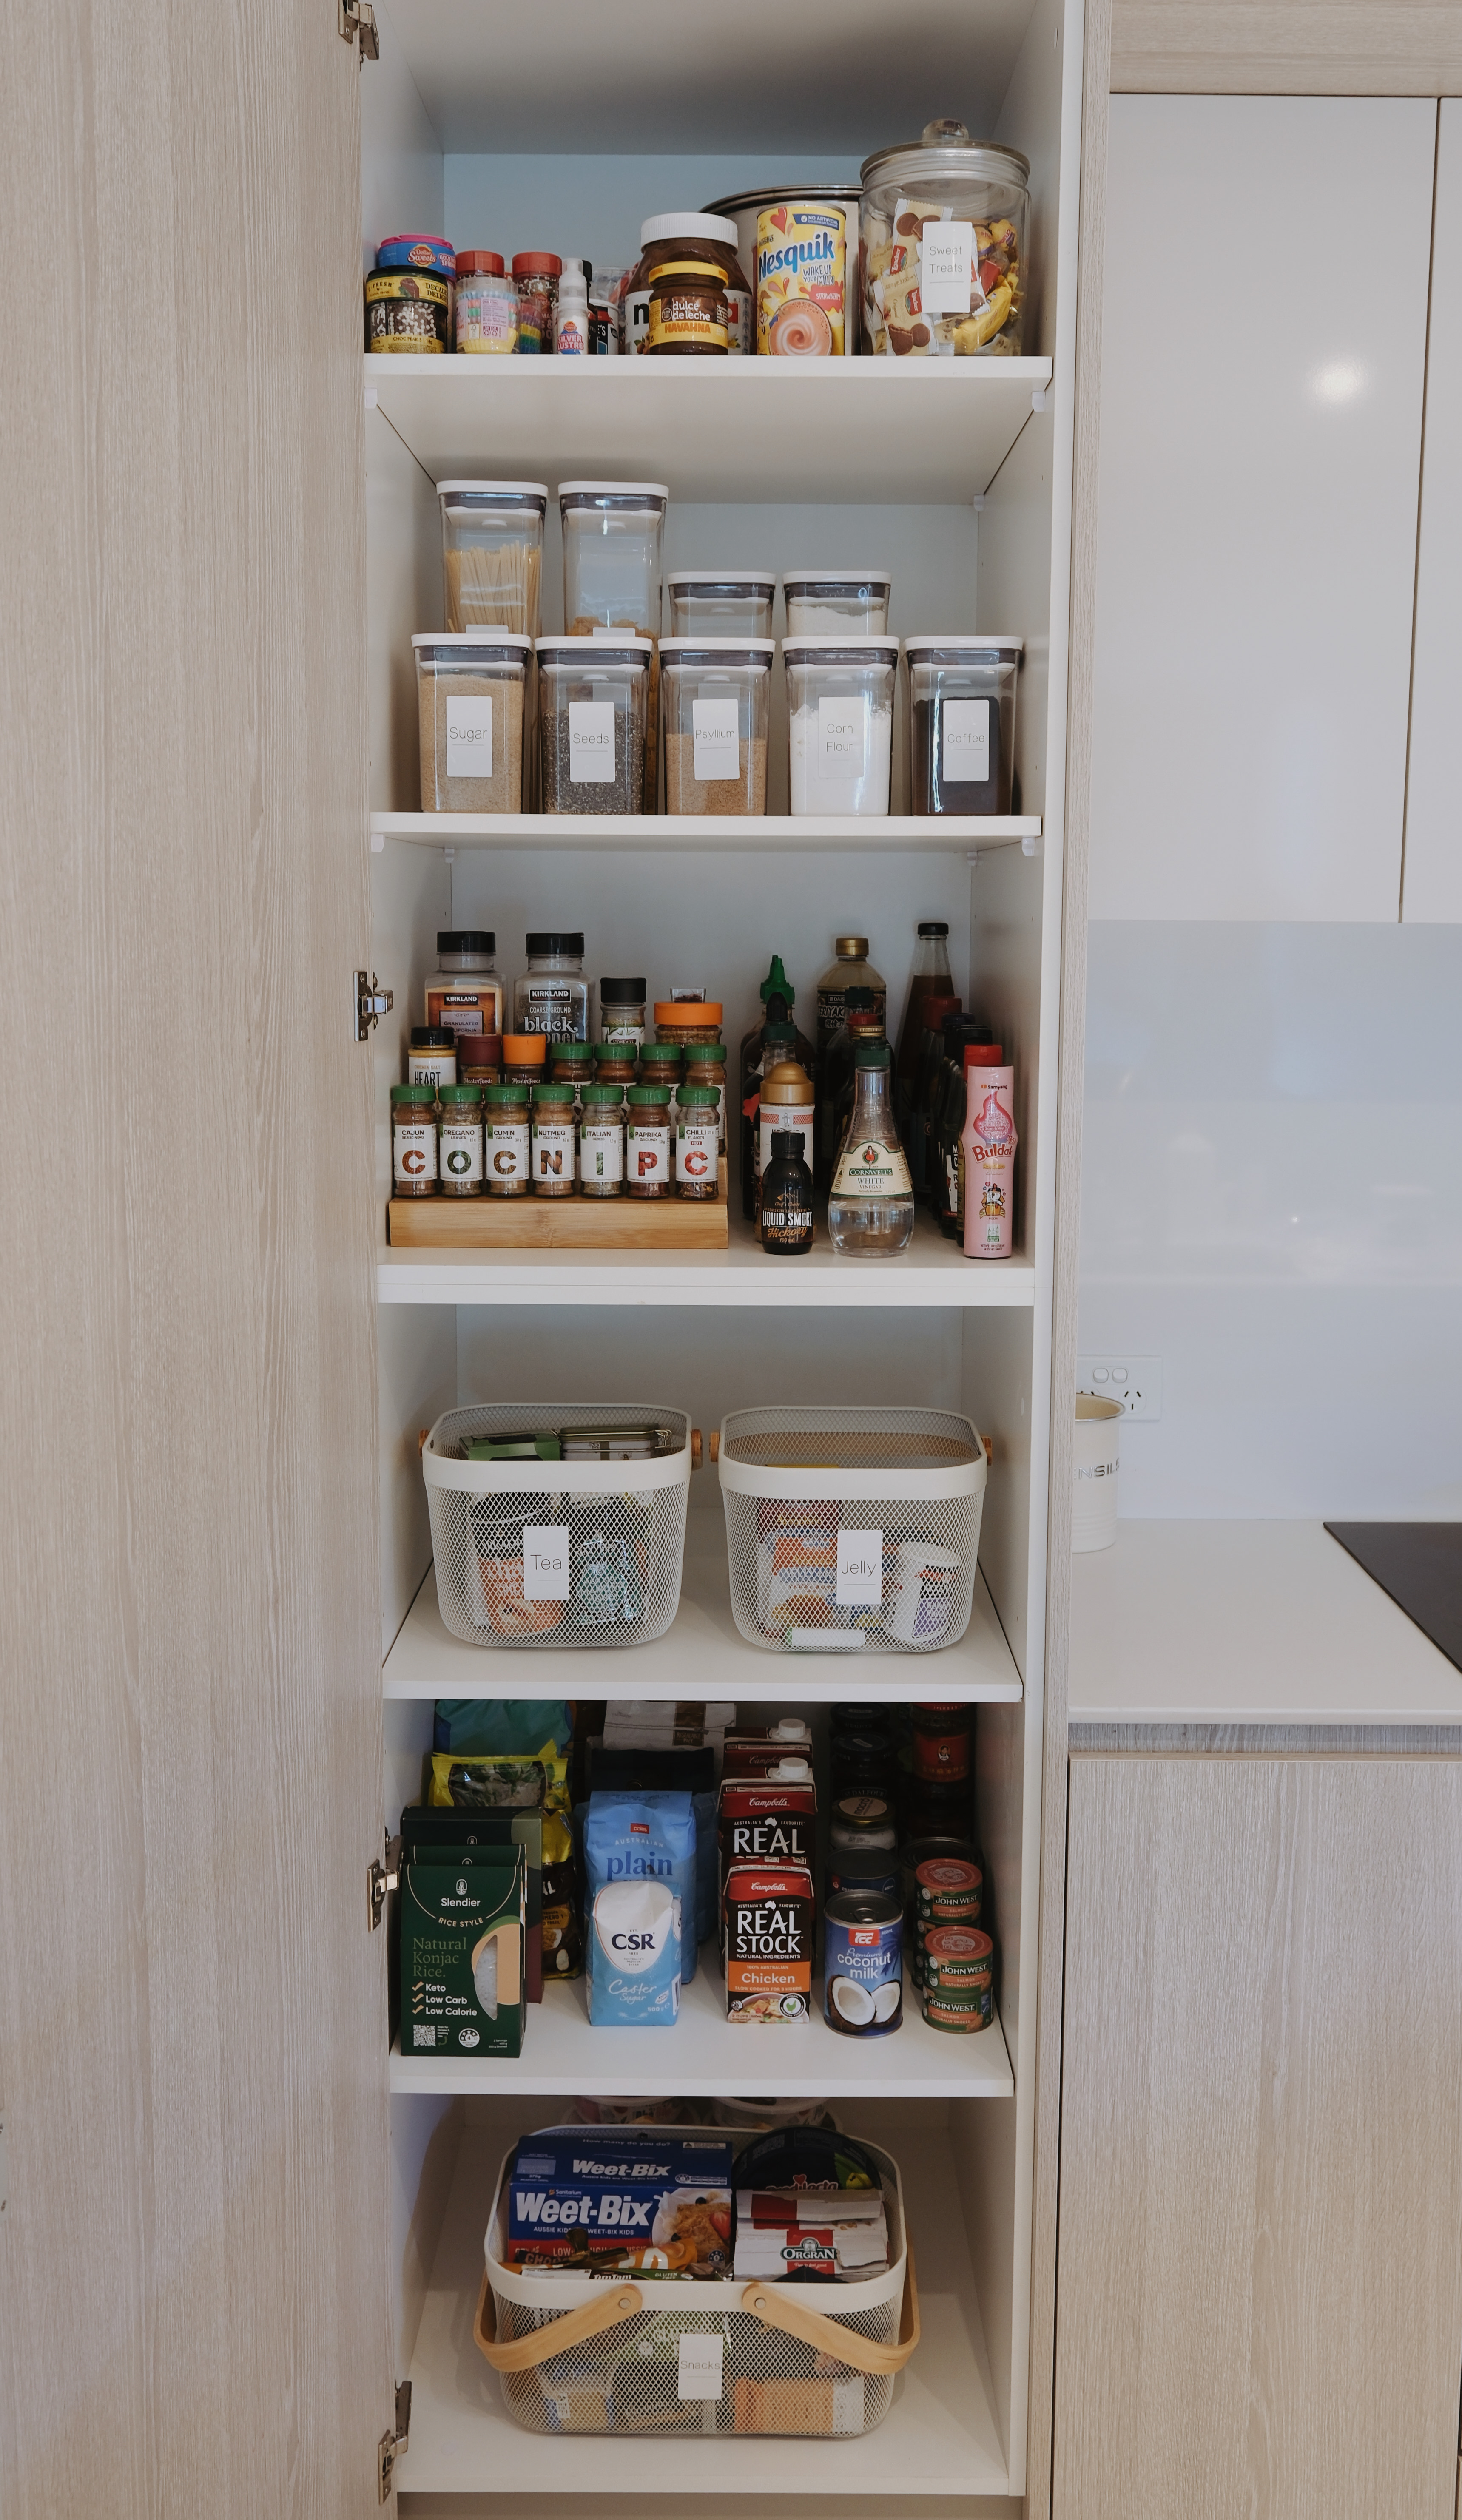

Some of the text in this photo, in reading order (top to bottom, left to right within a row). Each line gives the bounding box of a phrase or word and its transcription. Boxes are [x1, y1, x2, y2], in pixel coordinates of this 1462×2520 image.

[817, 216, 838, 225] ARTIFICIAL
[407, 251, 436, 263] Sweets
[930, 246, 962, 256] Sweet
[759, 232, 834, 283] Nesquik
[803, 264, 832, 276] WAKE UP
[929, 264, 963, 273] Treats
[816, 293, 841, 301] STRAWBERRY
[673, 300, 699, 311] dulce
[673, 310, 684, 320] de
[685, 310, 711, 321] leche
[665, 322, 711, 334] HAVANNA
[558, 335, 583, 344] SILVER
[557, 342, 584, 351] LUSTRE
[449, 727, 488, 743] Sugar
[695, 729, 735, 741] Psyllium
[827, 724, 853, 734] Corn
[573, 733, 609, 744] Seeds
[947, 733, 985, 743] Coffee
[826, 742, 853, 752] Flour
[524, 1016, 578, 1033] black
[414, 1071, 441, 1087] HEART
[972, 1143, 1013, 1162] Buldak
[402, 1150, 426, 1174] C
[447, 1150, 471, 1174] O
[494, 1150, 517, 1175] C
[540, 1150, 562, 1174] N
[596, 1152, 603, 1175] I
[638, 1151, 658, 1176] P
[685, 1151, 708, 1176] C
[762, 1210, 812, 1227] LIQUID SMOKE
[767, 1226, 808, 1238] Hickory
[530, 1554, 562, 1571] Tea
[842, 1561, 876, 1577] Jelly
[615, 1837, 663, 1847] AUSTRALIAN
[734, 1828, 805, 1854] REAL
[607, 1850, 674, 1881] plain
[441, 1898, 481, 1907] Slendier
[959, 1894, 978, 1904] WEST
[438, 1917, 484, 1928] RICE STYLE
[737, 1910, 802, 1935] REAL
[412, 1937, 467, 1950] Natural
[612, 1933, 656, 1950] CSR
[737, 1936, 801, 1953] STOCK
[846, 1947, 882, 1957] Premium
[413, 1951, 459, 1967] Konjac
[837, 1952, 891, 1967] coconut
[413, 1965, 446, 1977] Rice.
[850, 1967, 879, 1980] milk
[942, 1963, 987, 1975] JOHN WEST
[742, 1972, 795, 1983] Chicken
[426, 1983, 446, 1992] Keto
[608, 1979, 657, 1995] Caster
[426, 1995, 467, 2004] Low Carb
[620, 1992, 646, 2005] Sugar
[930, 1998, 950, 2011] JOHN
[426, 2007, 478, 2016] Low Calorie
[572, 2159, 672, 2177] Weet-Bix
[516, 2192, 653, 2226] Weet-Bix
[783, 2248, 835, 2259] ORGRAN
[681, 2360, 720, 2370] Snacks
